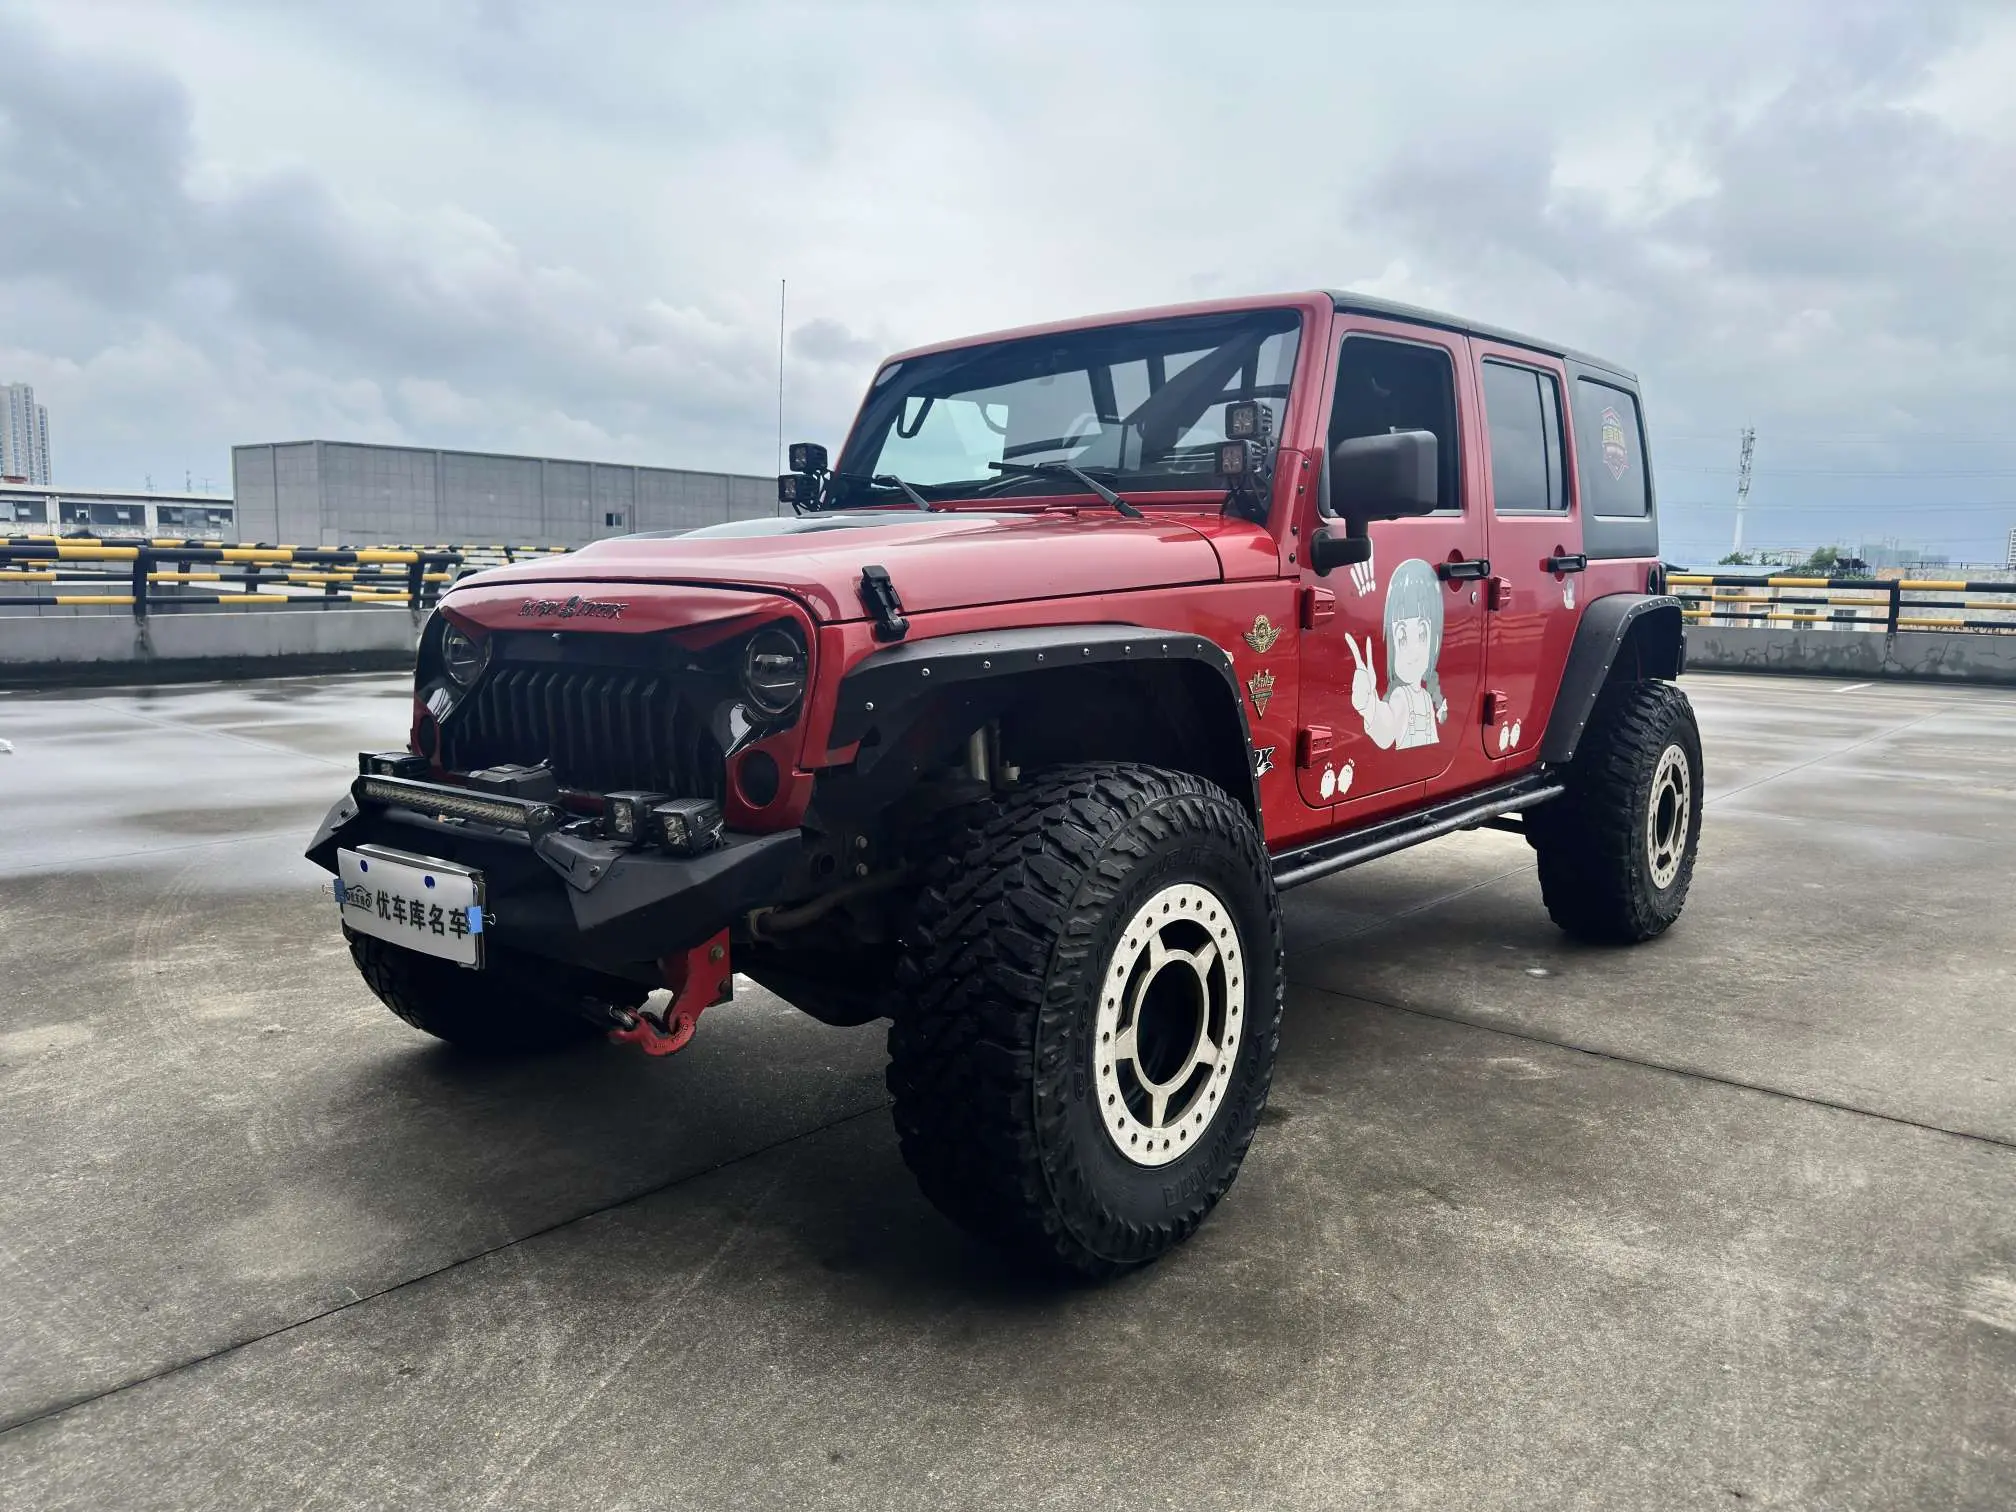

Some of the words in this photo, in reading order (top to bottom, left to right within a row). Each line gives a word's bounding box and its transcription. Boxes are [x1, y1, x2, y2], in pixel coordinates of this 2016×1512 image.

[376, 889, 469, 939] 优车库名车
